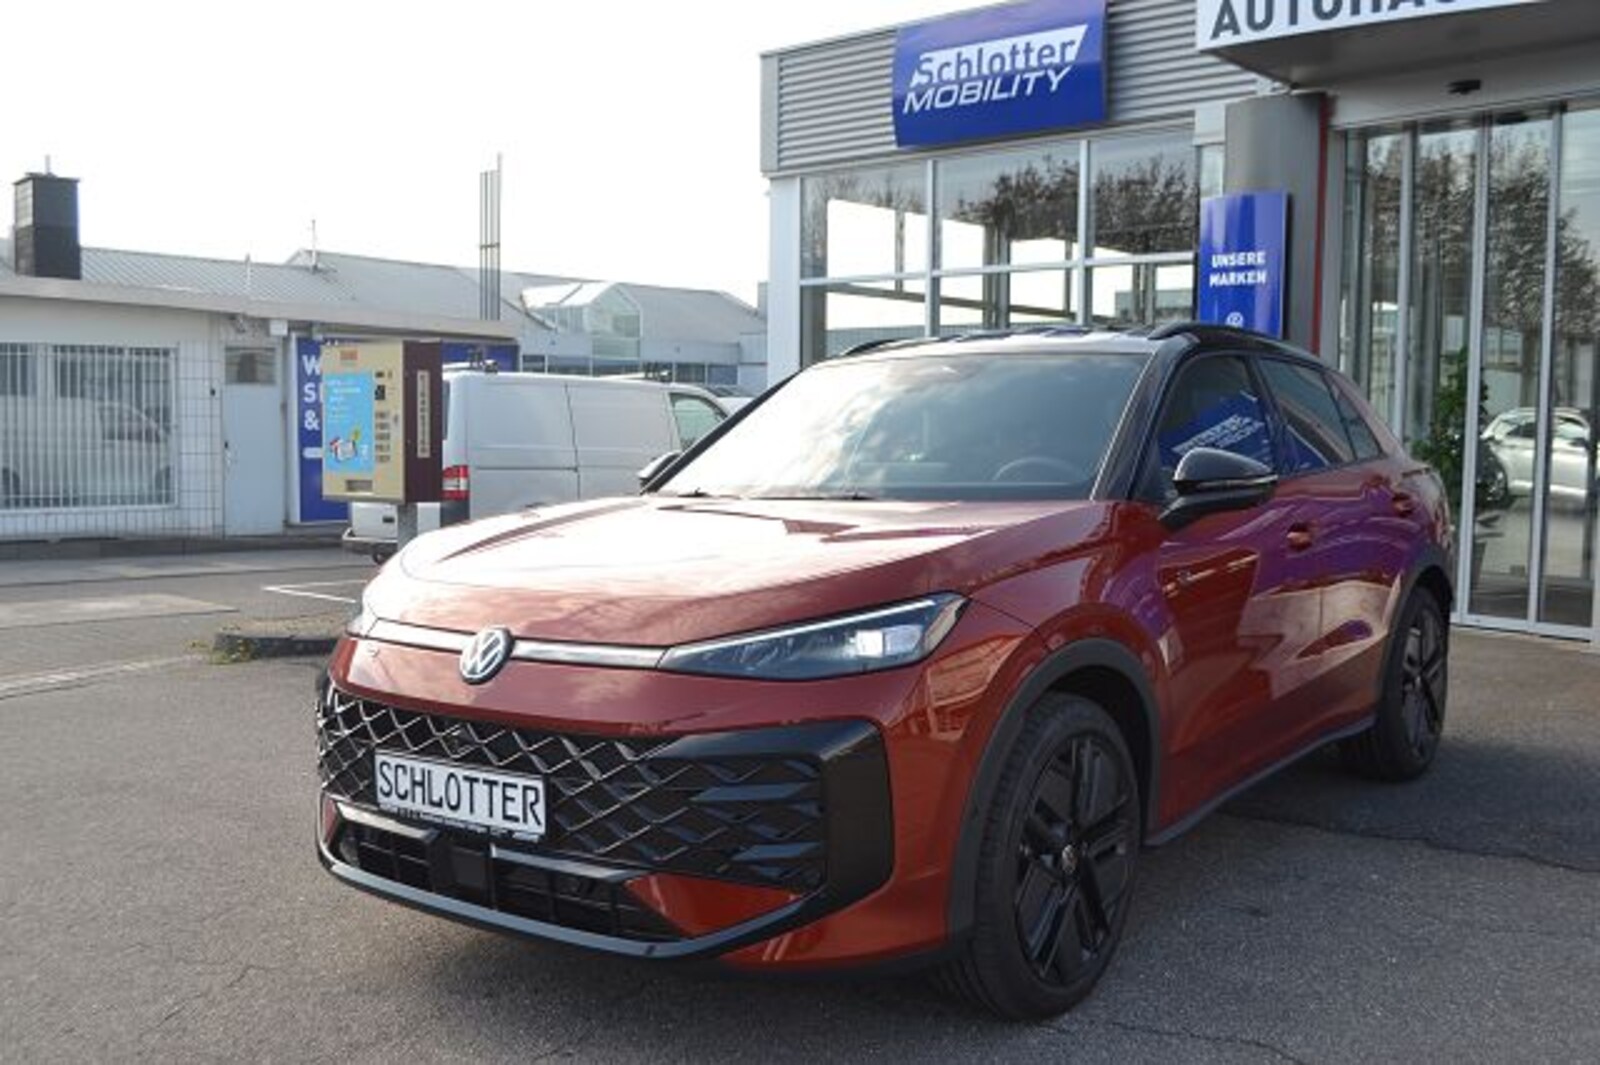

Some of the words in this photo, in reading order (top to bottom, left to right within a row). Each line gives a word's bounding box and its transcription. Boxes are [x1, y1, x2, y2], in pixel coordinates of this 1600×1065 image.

[1210, 0, 1452, 40] AUTO
[917, 39, 1076, 84] Schlotter
[903, 65, 1073, 114] MOBILITY
[1209, 270, 1267, 287] MARKEN
[1212, 251, 1266, 268] UNSERE
[379, 761, 542, 827] SCHLOTTER
